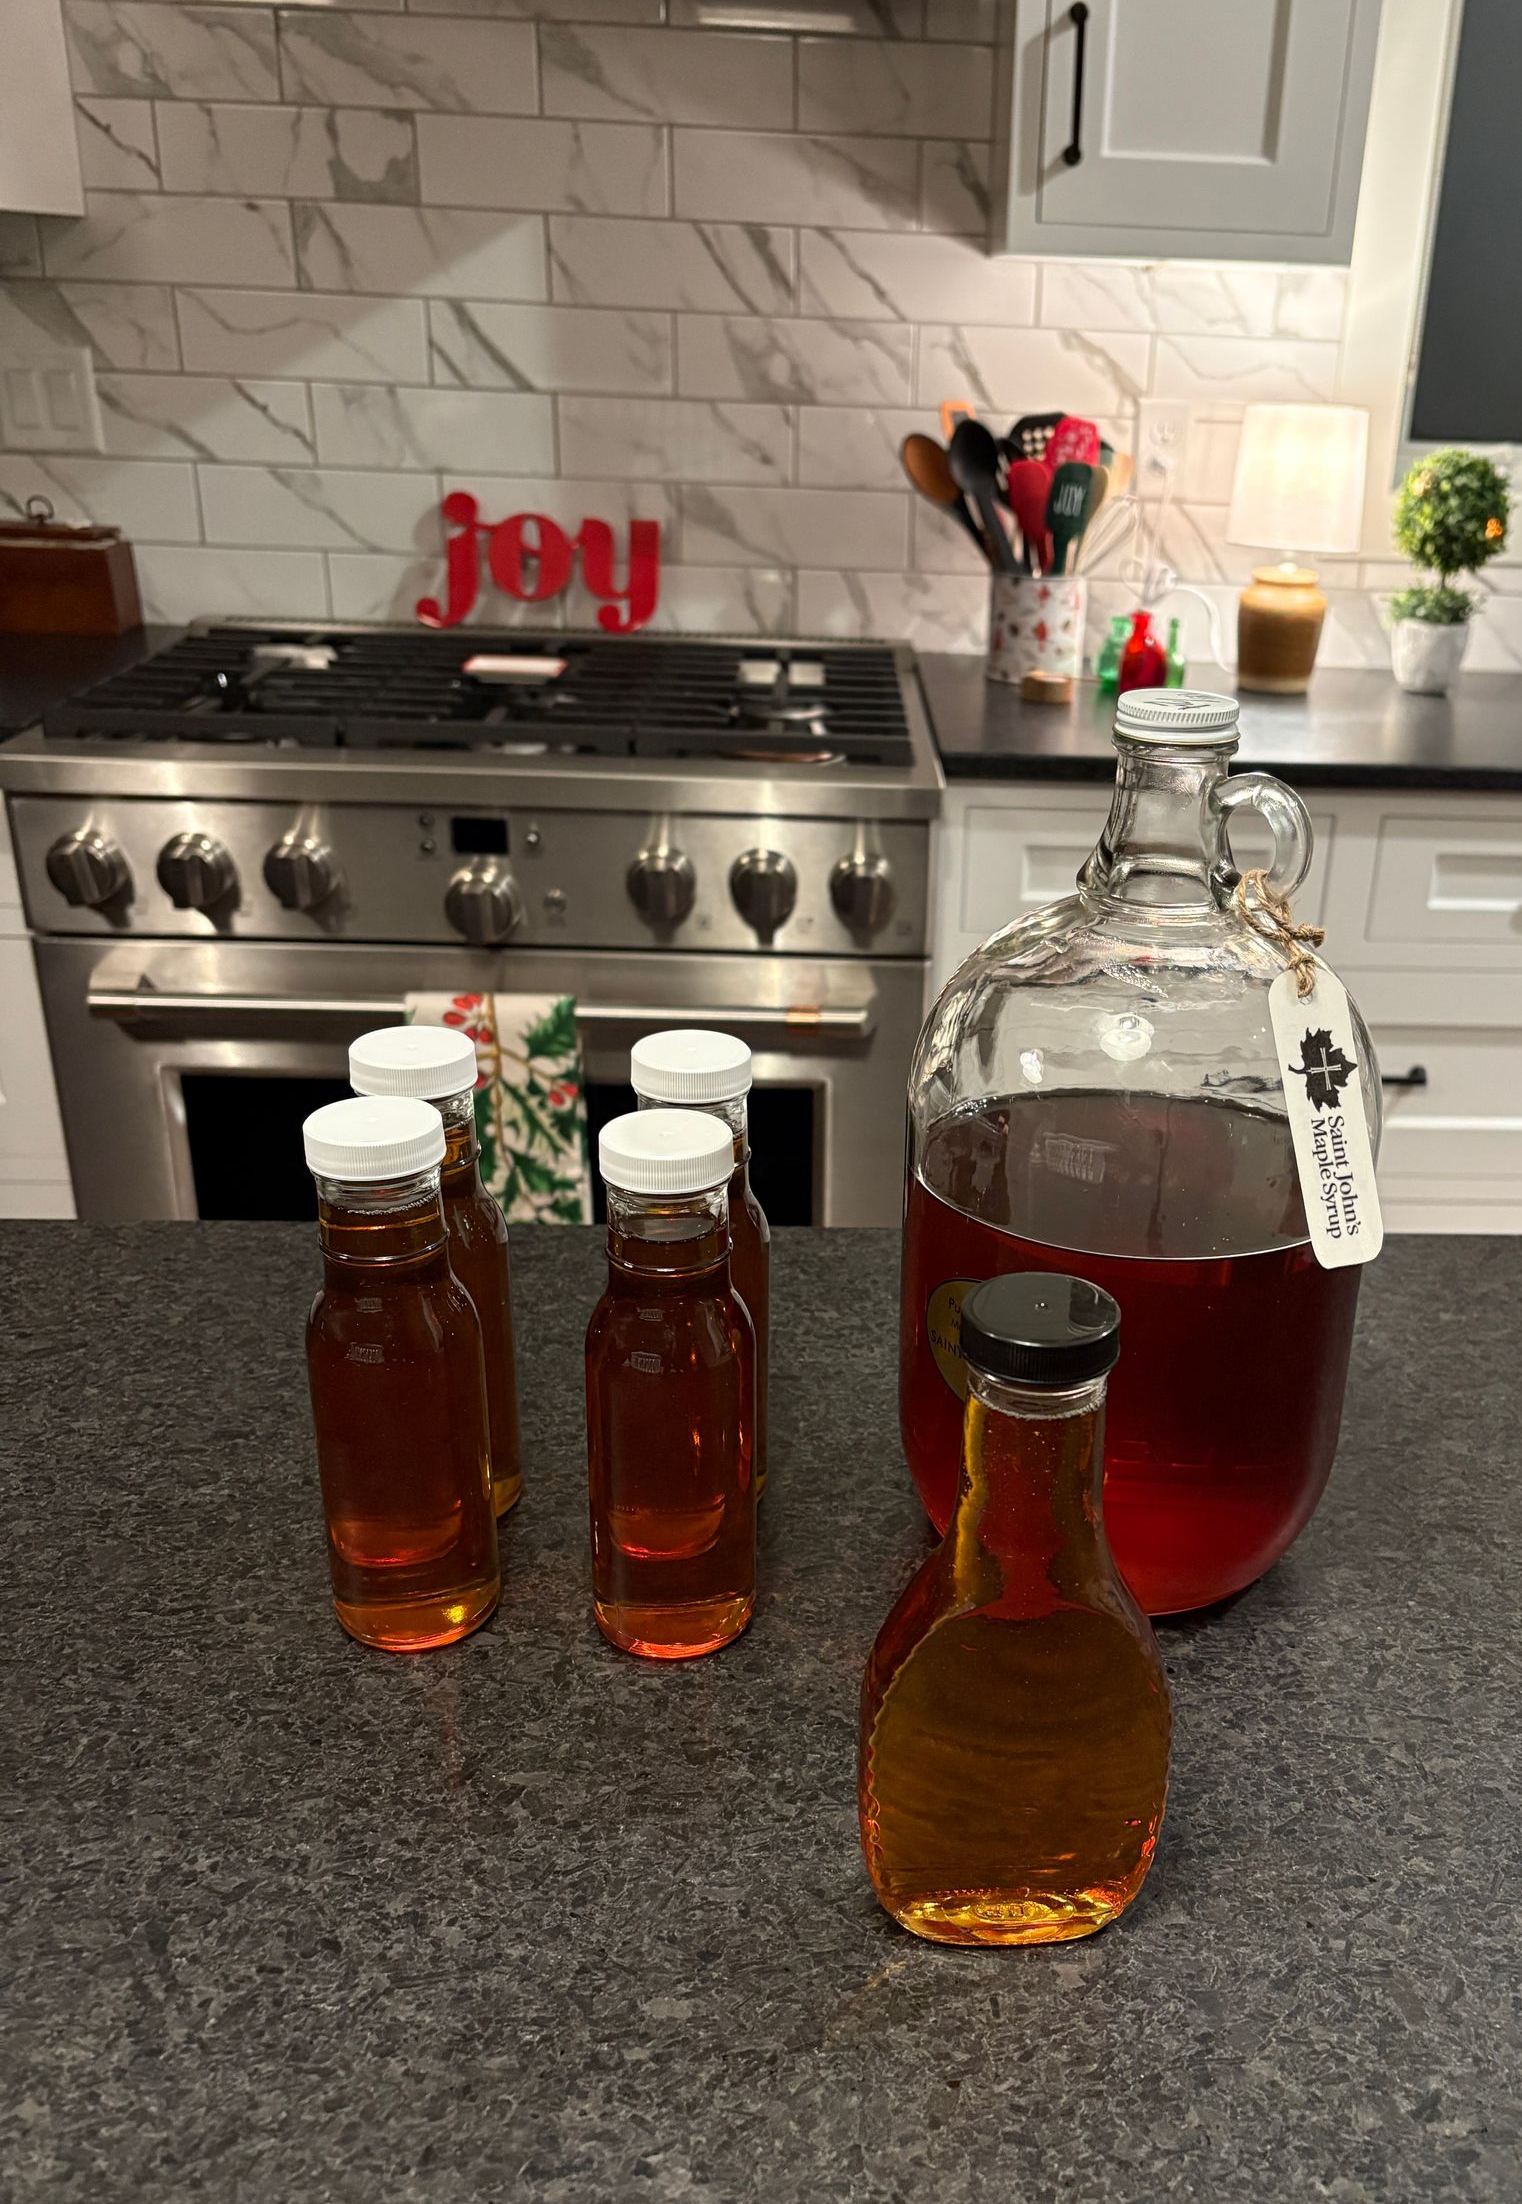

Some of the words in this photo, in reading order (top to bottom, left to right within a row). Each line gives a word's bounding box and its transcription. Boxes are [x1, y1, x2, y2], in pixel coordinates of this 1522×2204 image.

[416, 492, 660, 634] joy
[1311, 1118, 1333, 1180] Maple
[1328, 1115, 1349, 1167] Saint
[1320, 1183, 1342, 1239] Syrup
[1334, 1172, 1361, 1236] John's
